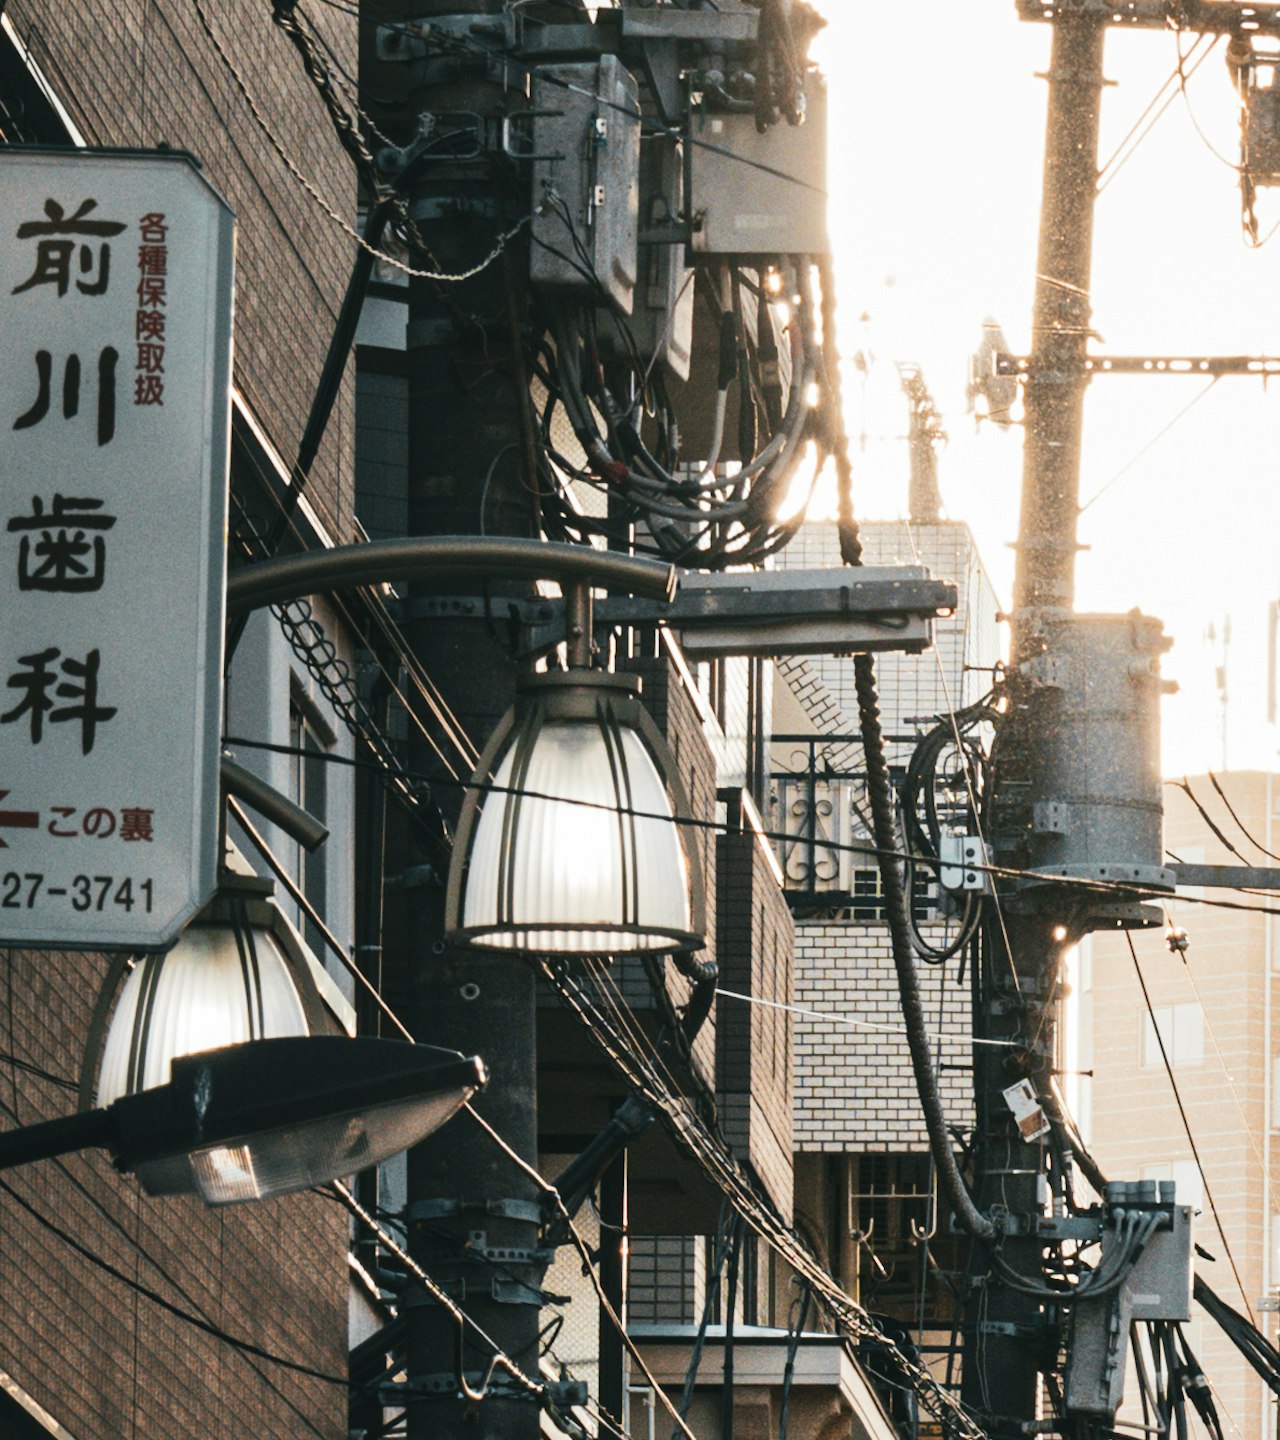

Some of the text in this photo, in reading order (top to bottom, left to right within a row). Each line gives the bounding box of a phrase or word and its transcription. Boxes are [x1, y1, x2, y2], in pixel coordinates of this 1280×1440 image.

[134, 211, 170, 406] 各種保険取扱
[1, 197, 129, 756] 前川歯科
[46, 805, 155, 844] この裏
